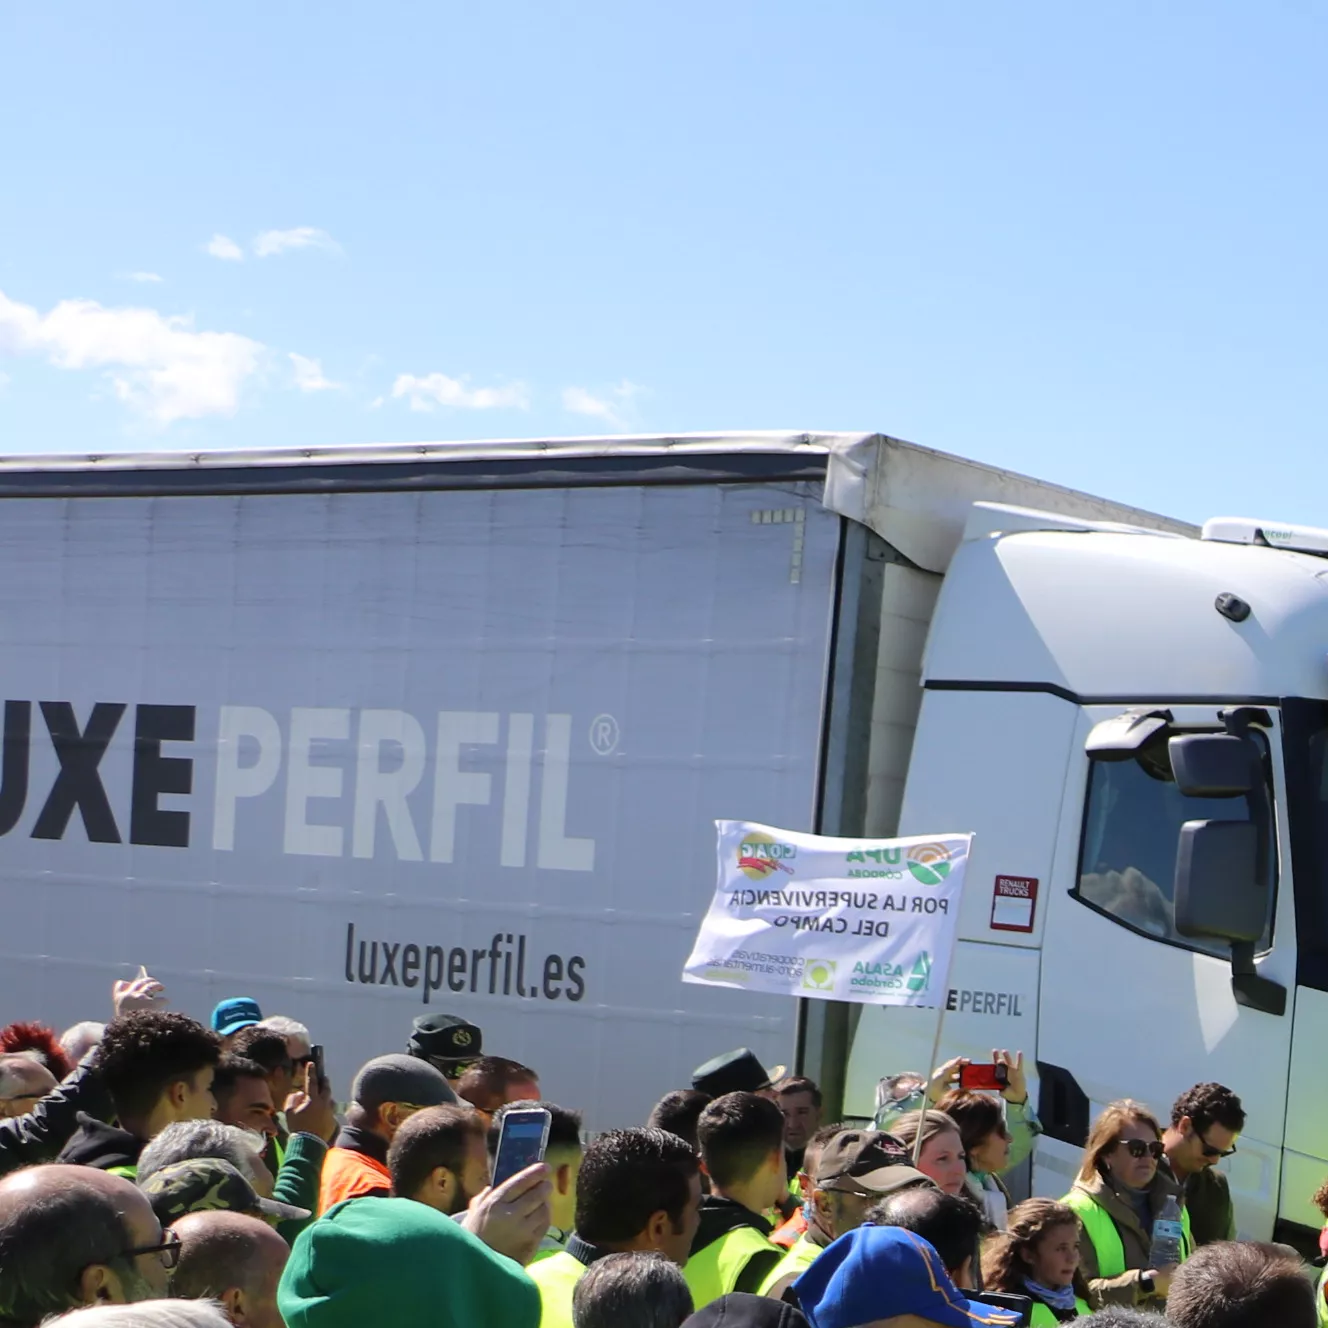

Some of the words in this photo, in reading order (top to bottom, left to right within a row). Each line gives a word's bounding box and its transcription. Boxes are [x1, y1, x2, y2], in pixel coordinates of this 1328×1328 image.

[999, 879, 1030, 889] RENAULT
[999, 886, 1029, 897] TRUCKS
[345, 922, 586, 1003] luxeperfil.es
